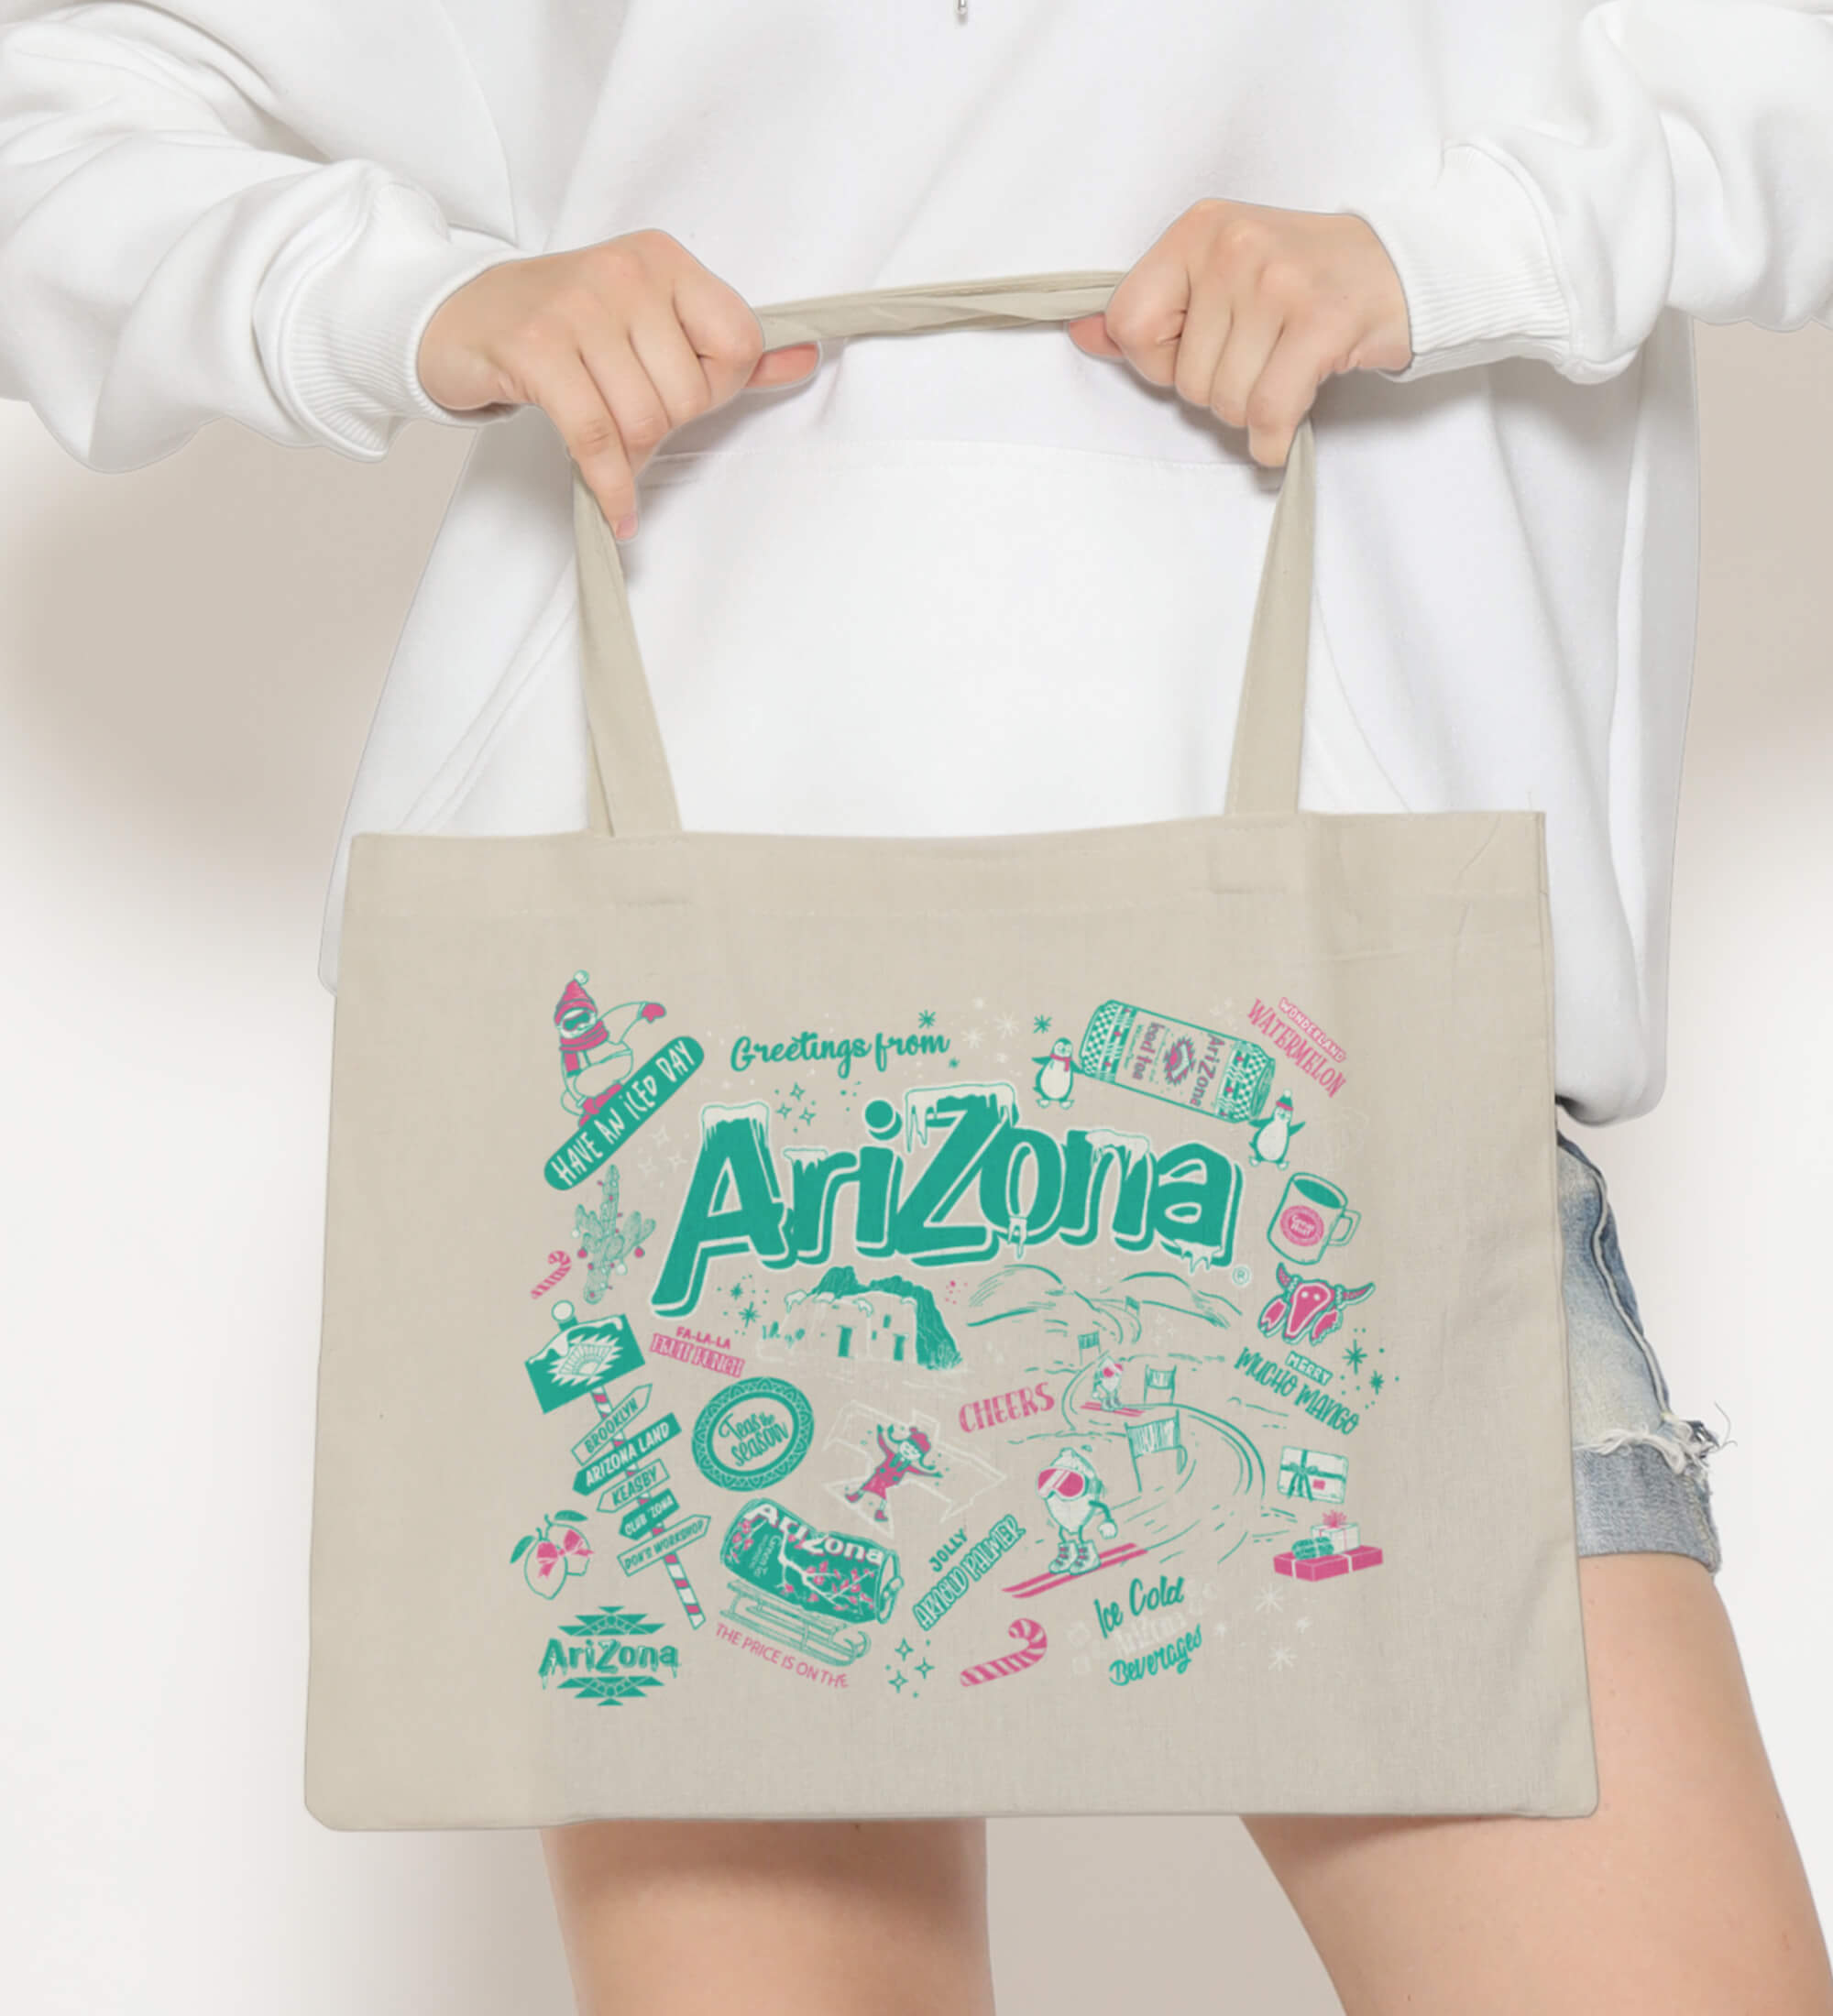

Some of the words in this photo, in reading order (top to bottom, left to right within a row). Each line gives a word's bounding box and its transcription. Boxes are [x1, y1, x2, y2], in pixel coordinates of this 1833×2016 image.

[730, 1032, 872, 1079] Greetings
[875, 1032, 950, 1073] from
[1247, 997, 1346, 1098] WATERMELON
[1279, 997, 1346, 1063] WONDERLAND
[551, 1132, 603, 1186] HAVE
[594, 1107, 625, 1145] AN
[655, 1040, 695, 1082] DAY
[650, 1084, 1244, 1318] AriZona
[675, 1326, 731, 1350] FA-LA-LA
[1285, 1351, 1334, 1386] MERRY
[958, 1382, 1055, 1433] CHEERS
[1234, 1347, 1299, 1397] MUCHO
[1294, 1384, 1360, 1435] MANGO
[585, 1397, 638, 1453] BROOKLYN
[587, 1443, 638, 1487] ARIZONA
[638, 1422, 670, 1452] LAND
[611, 1466, 657, 1506] KEASBY
[912, 1565, 969, 1631] ARNOLD
[960, 1514, 1026, 1582] PALMER
[928, 1528, 968, 1572] JOLLY
[1093, 1598, 1124, 1639] Ice
[1129, 1575, 1185, 1616] Cold
[538, 1638, 681, 1690] AriZona
[716, 1622, 743, 1646] THE
[741, 1637, 783, 1664] PRICE
[780, 1655, 796, 1671] IS
[796, 1662, 820, 1682] ON
[821, 1669, 850, 1689] THE
[1109, 1623, 1202, 1686] Beverages
